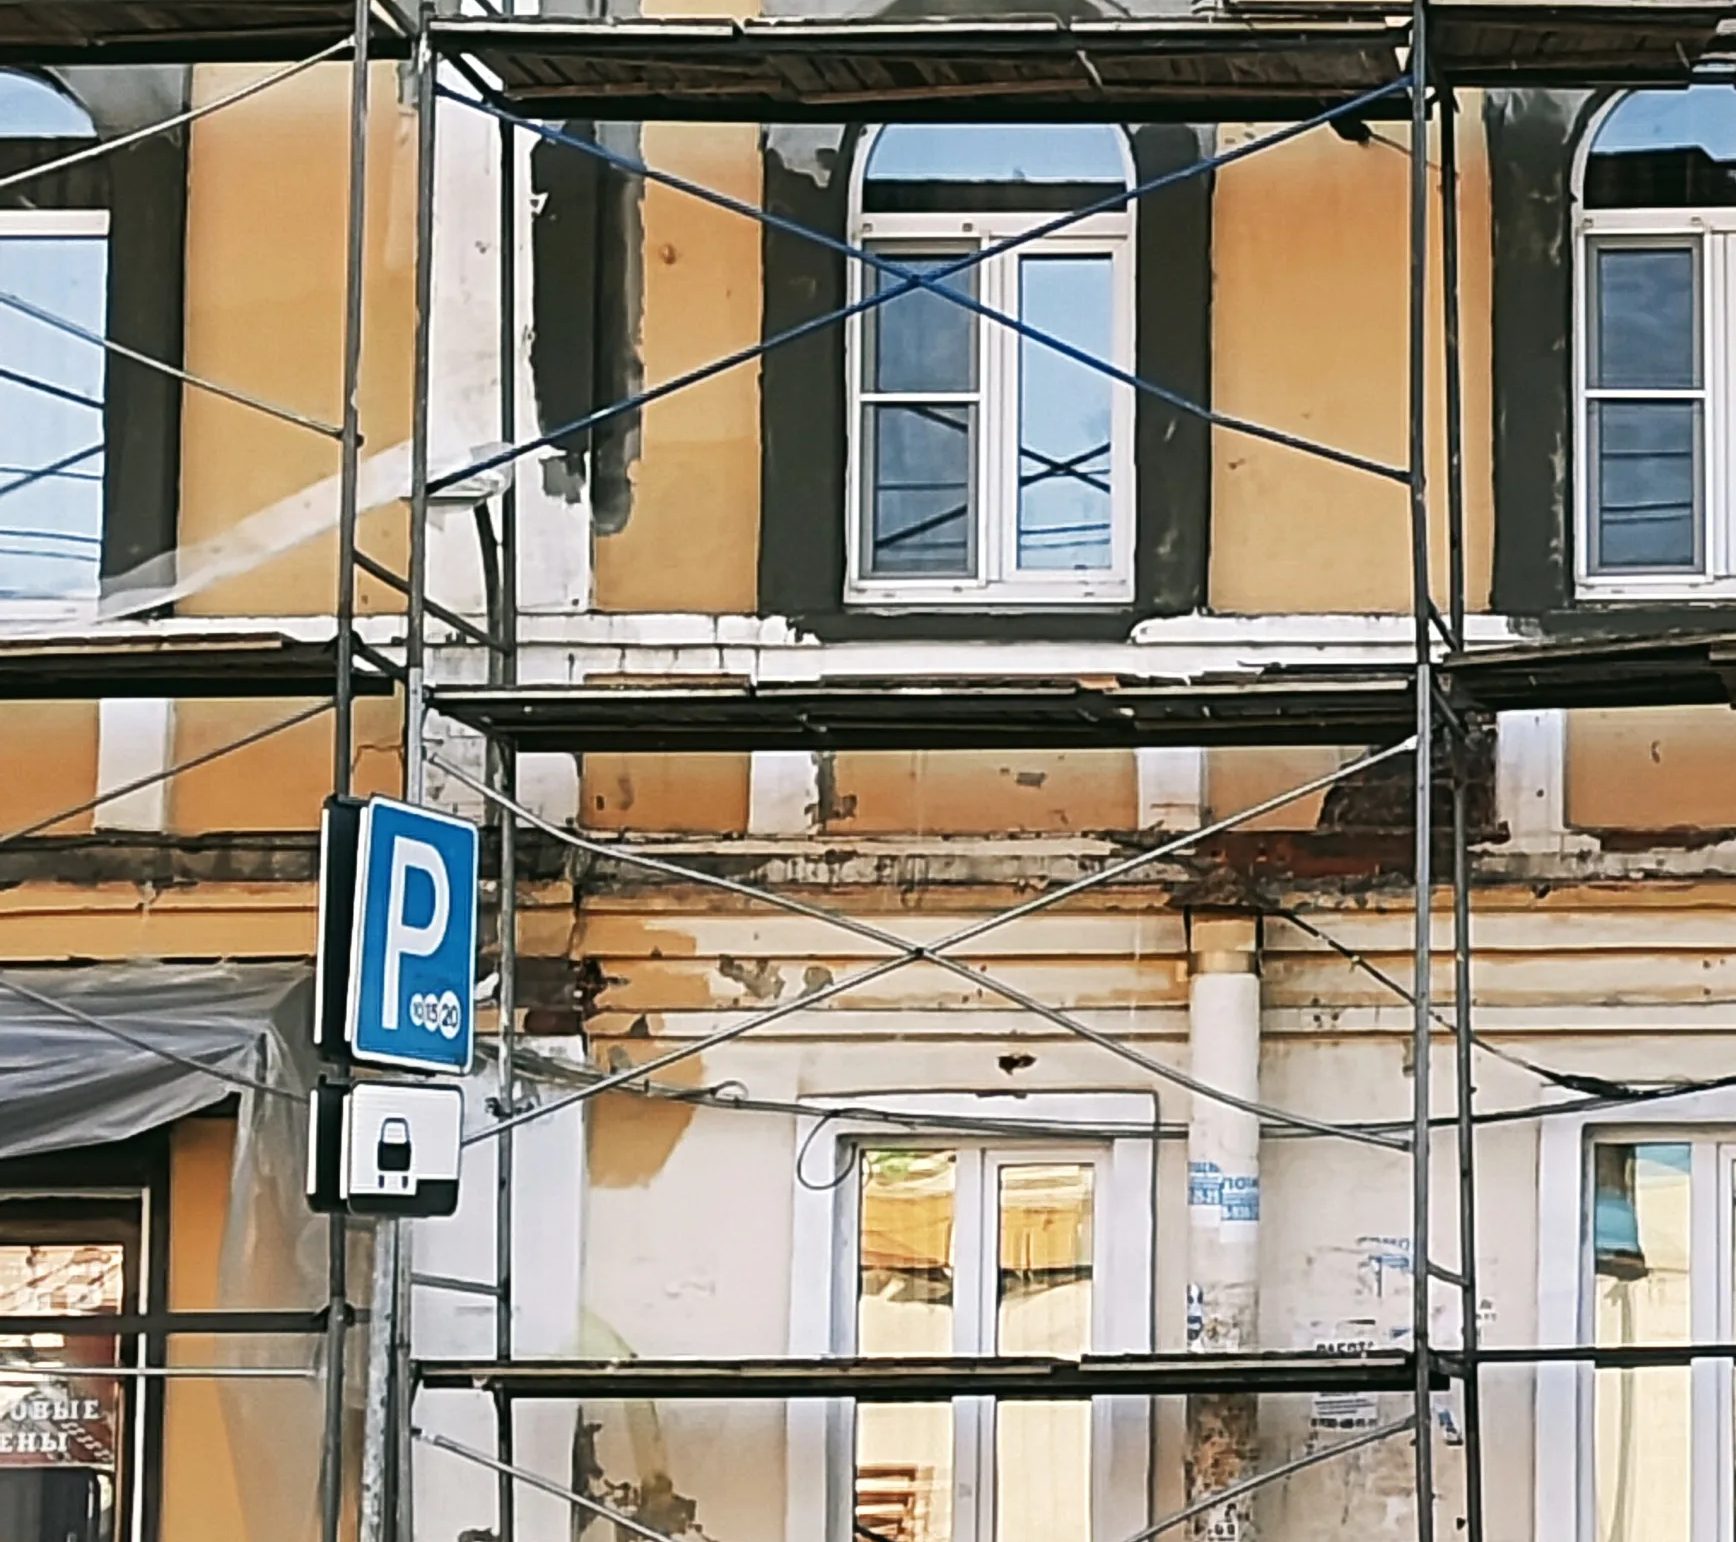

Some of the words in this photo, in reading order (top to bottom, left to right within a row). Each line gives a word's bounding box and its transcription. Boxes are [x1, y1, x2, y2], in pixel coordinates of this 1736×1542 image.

[382, 835, 450, 1030] P
[442, 1003, 458, 1028] 20
[7, 1400, 100, 1420] ОВЫЕ
